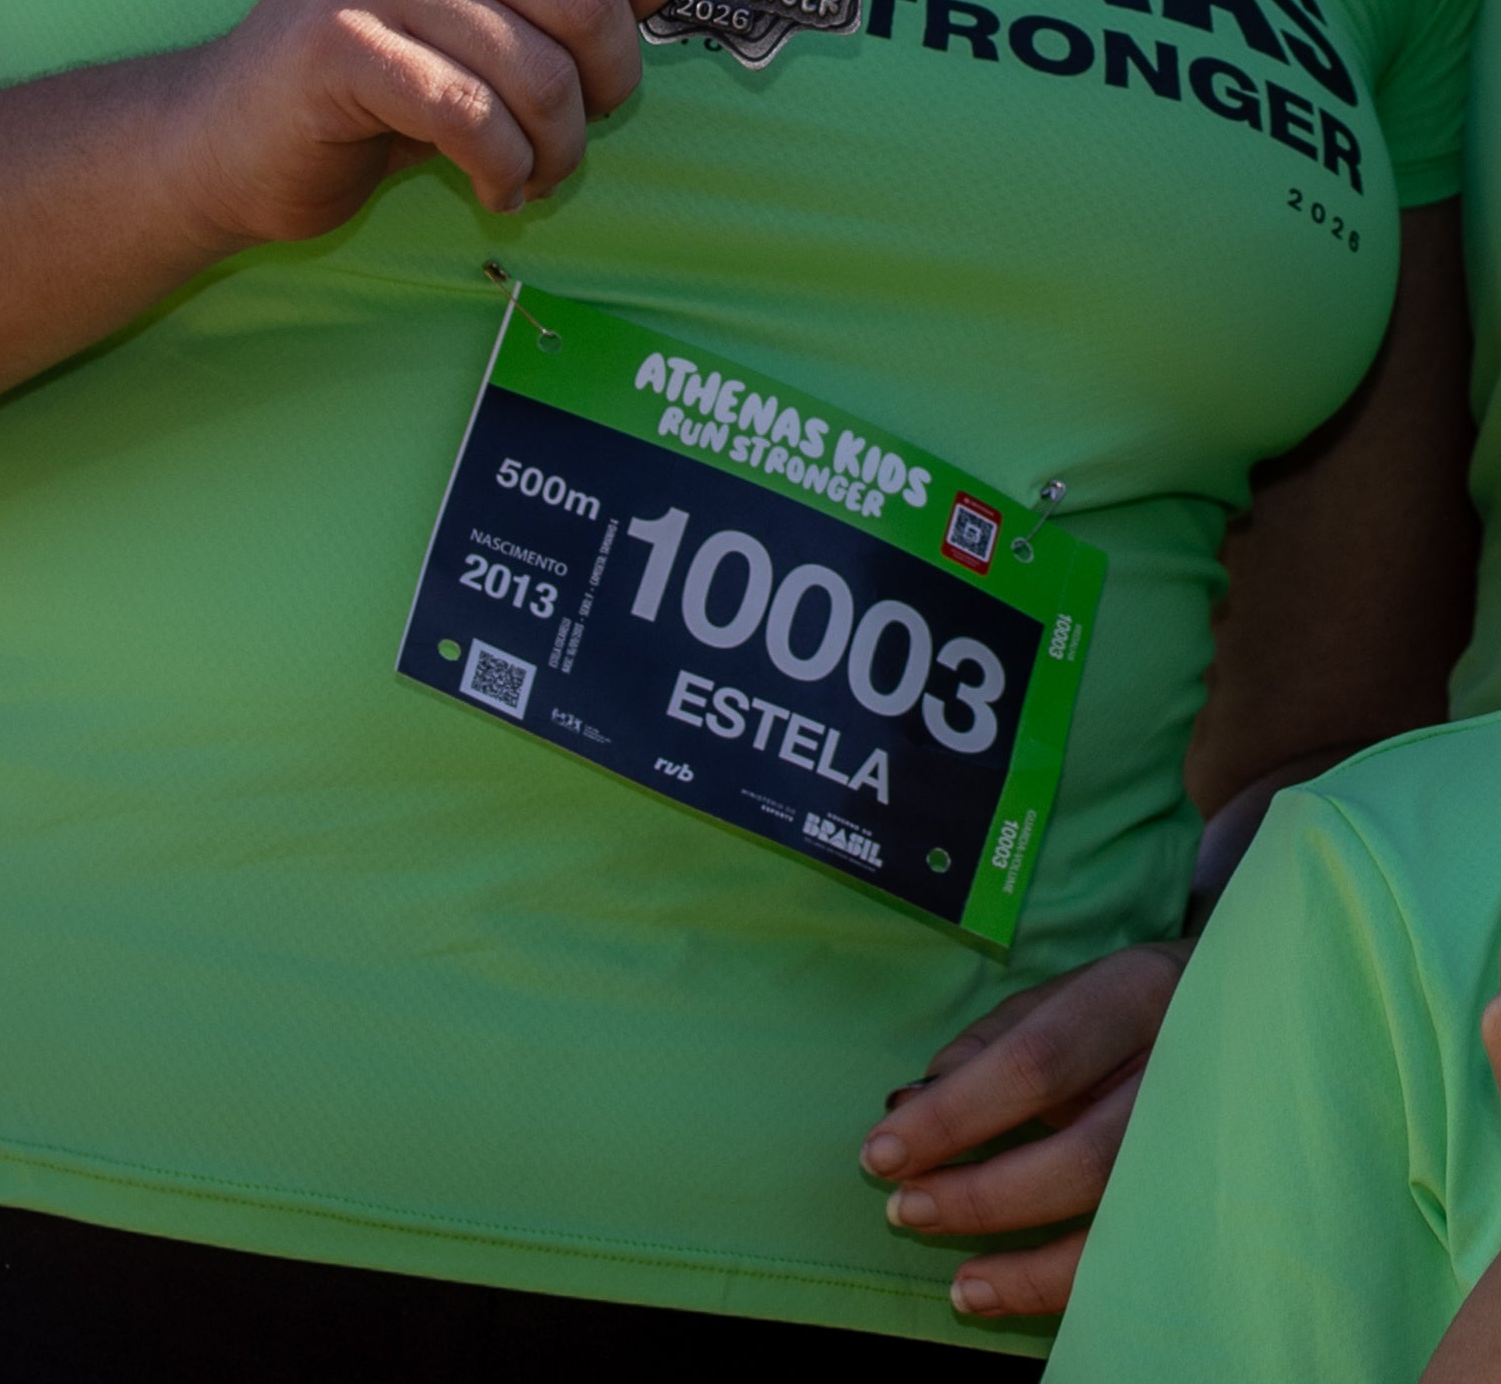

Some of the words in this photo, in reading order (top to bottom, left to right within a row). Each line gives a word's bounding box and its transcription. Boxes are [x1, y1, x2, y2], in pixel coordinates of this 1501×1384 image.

[1286, 187, 1361, 253] 2026
[634, 352, 829, 458] ATHENAS
[833, 430, 932, 508] KIDS
[658, 406, 729, 453] RUN
[729, 435, 885, 518] STRONGER
[496, 457, 601, 521] 500m
[470, 528, 568, 577] NASCIMENTO
[459, 553, 558, 619] 2013
[626, 506, 1006, 755] 10003
[665, 669, 890, 805] ESTELA
[802, 811, 884, 869] BRASIL
[992, 820, 1019, 870] 10003
